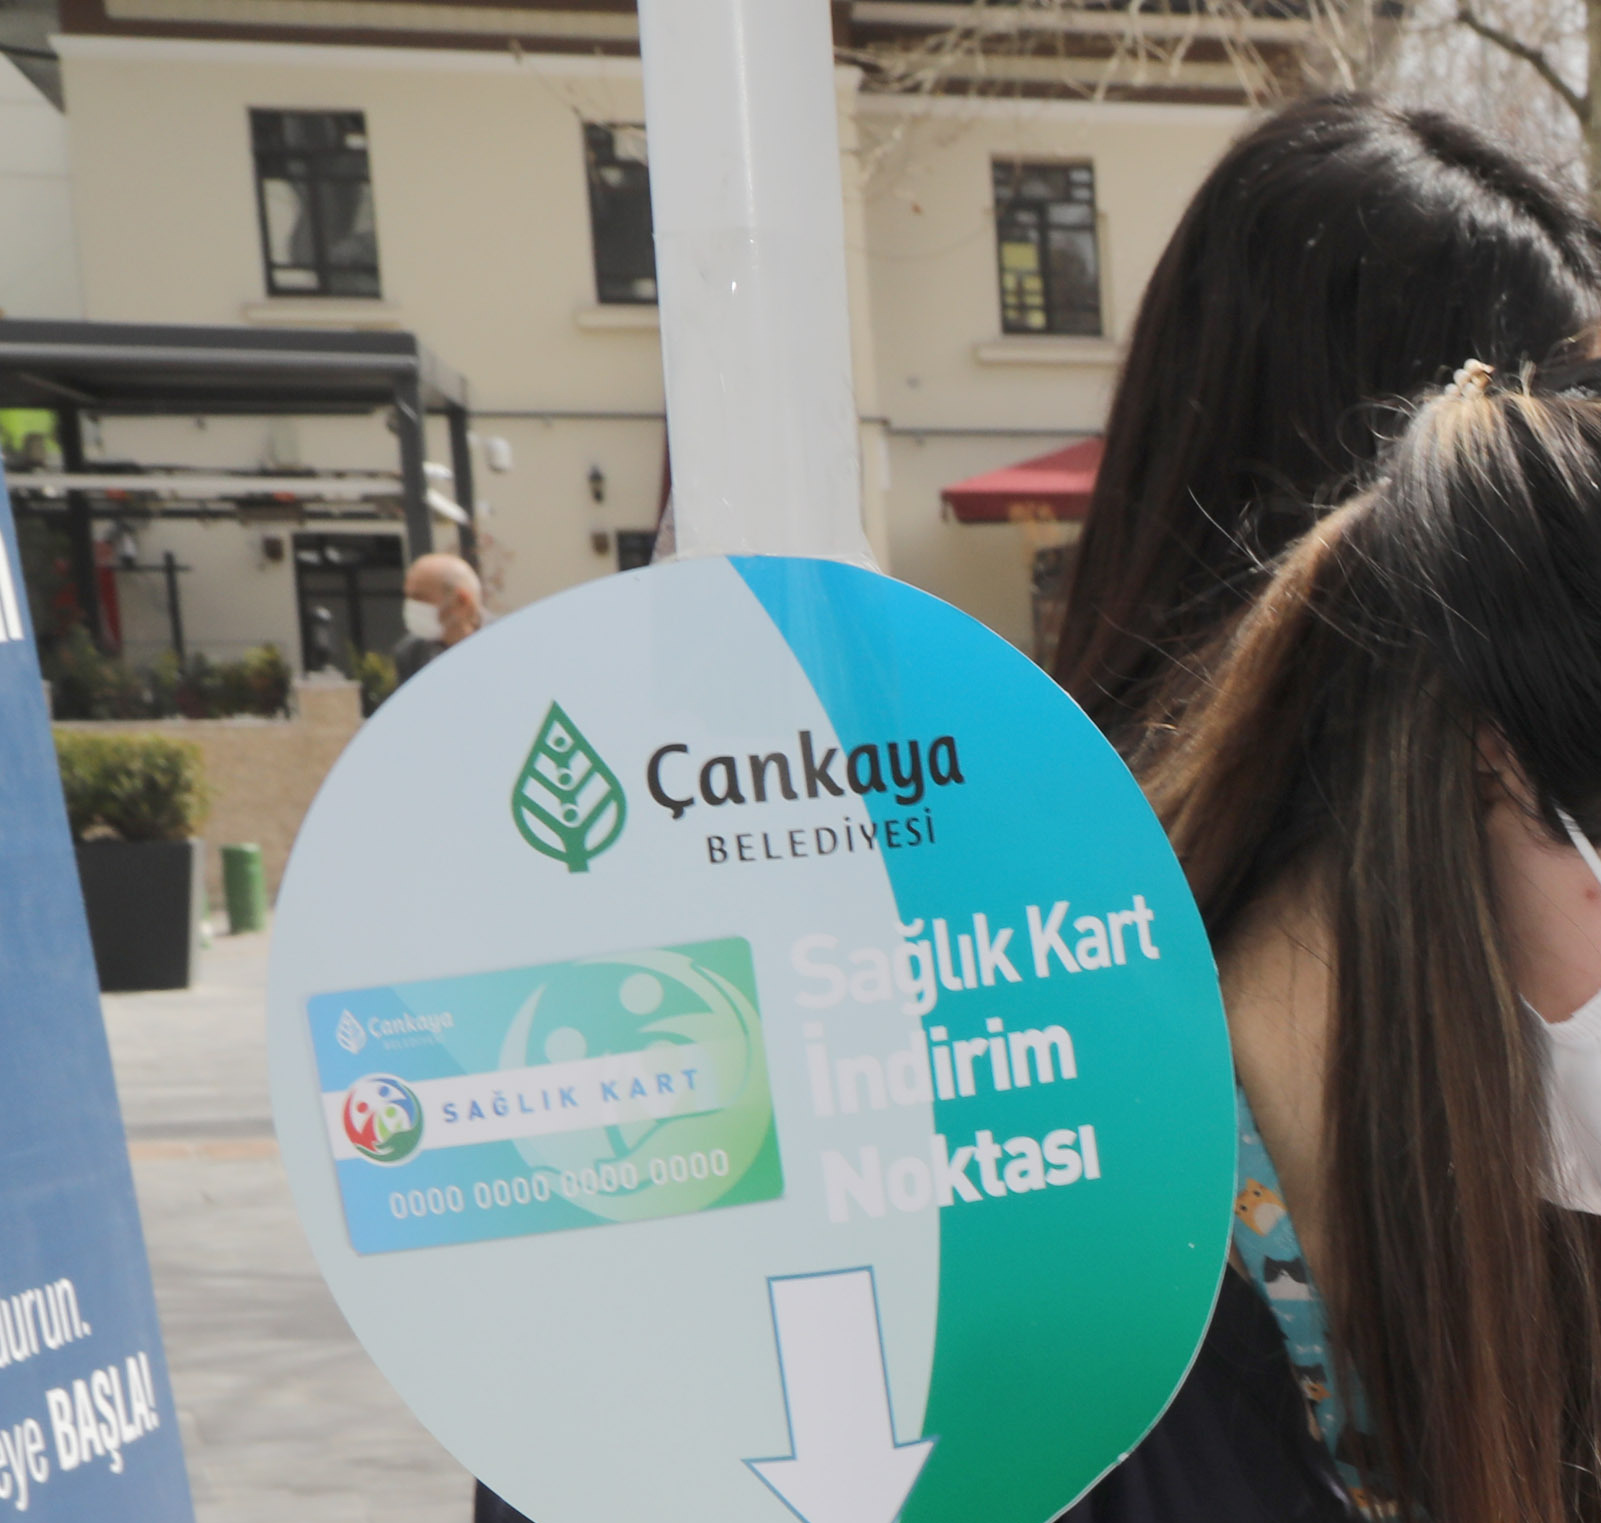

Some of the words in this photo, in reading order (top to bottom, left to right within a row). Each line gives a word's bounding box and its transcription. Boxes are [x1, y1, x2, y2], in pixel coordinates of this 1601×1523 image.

[645, 730, 965, 820] Çankaya
[705, 806, 937, 866] BELEDİYESİ
[790, 911, 1025, 1018] Sağlık
[1027, 894, 1162, 979] Kart
[442, 1085, 578, 1124] SAĞLIK
[600, 1067, 699, 1102] KART
[803, 1015, 1078, 1119] İndirim
[388, 1184, 465, 1220] 0000
[474, 1173, 551, 1209] 0000
[559, 1161, 639, 1197] 0000
[648, 1148, 730, 1187] 0000
[819, 1124, 1102, 1223] Noktası
[0, 1278, 92, 1369] urun.
[45, 1351, 160, 1475] BAŞLA!
